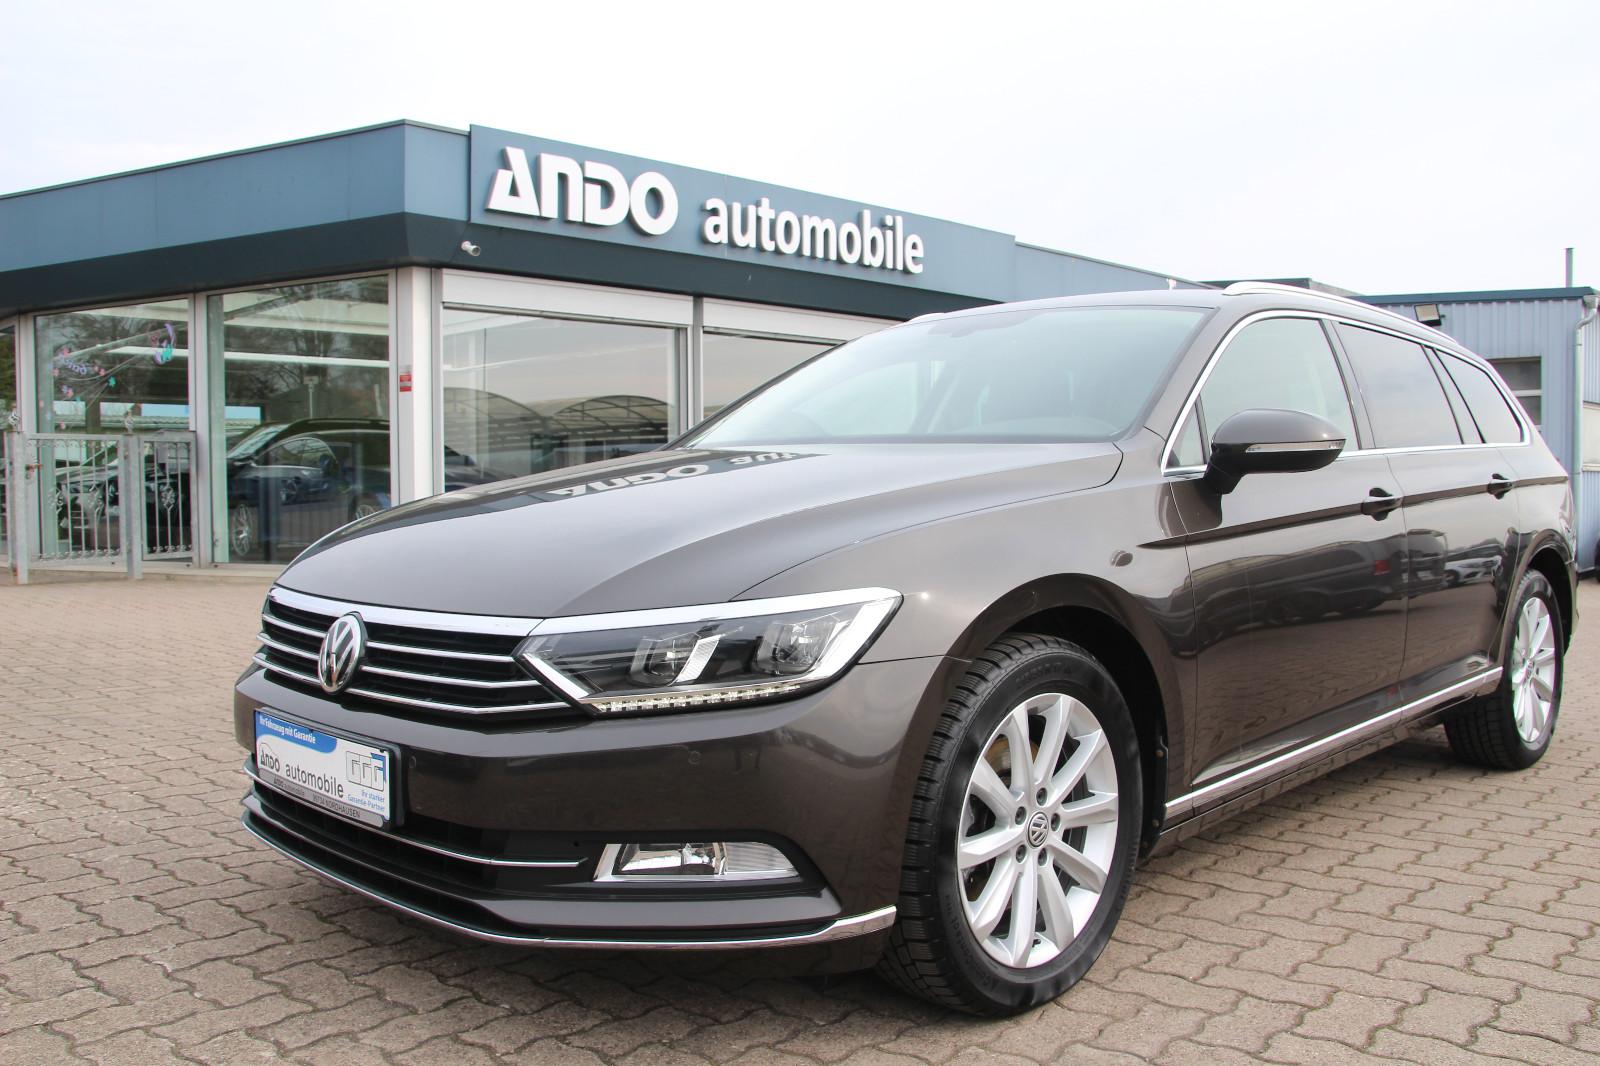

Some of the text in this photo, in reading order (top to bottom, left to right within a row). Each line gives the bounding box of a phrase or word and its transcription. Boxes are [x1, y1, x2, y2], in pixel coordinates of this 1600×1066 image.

[485, 146, 924, 274] ANDO automobile
[293, 728, 316, 744] Garantie
[285, 763, 344, 799] automobile
[324, 797, 361, 818] NORDHAUSEN
